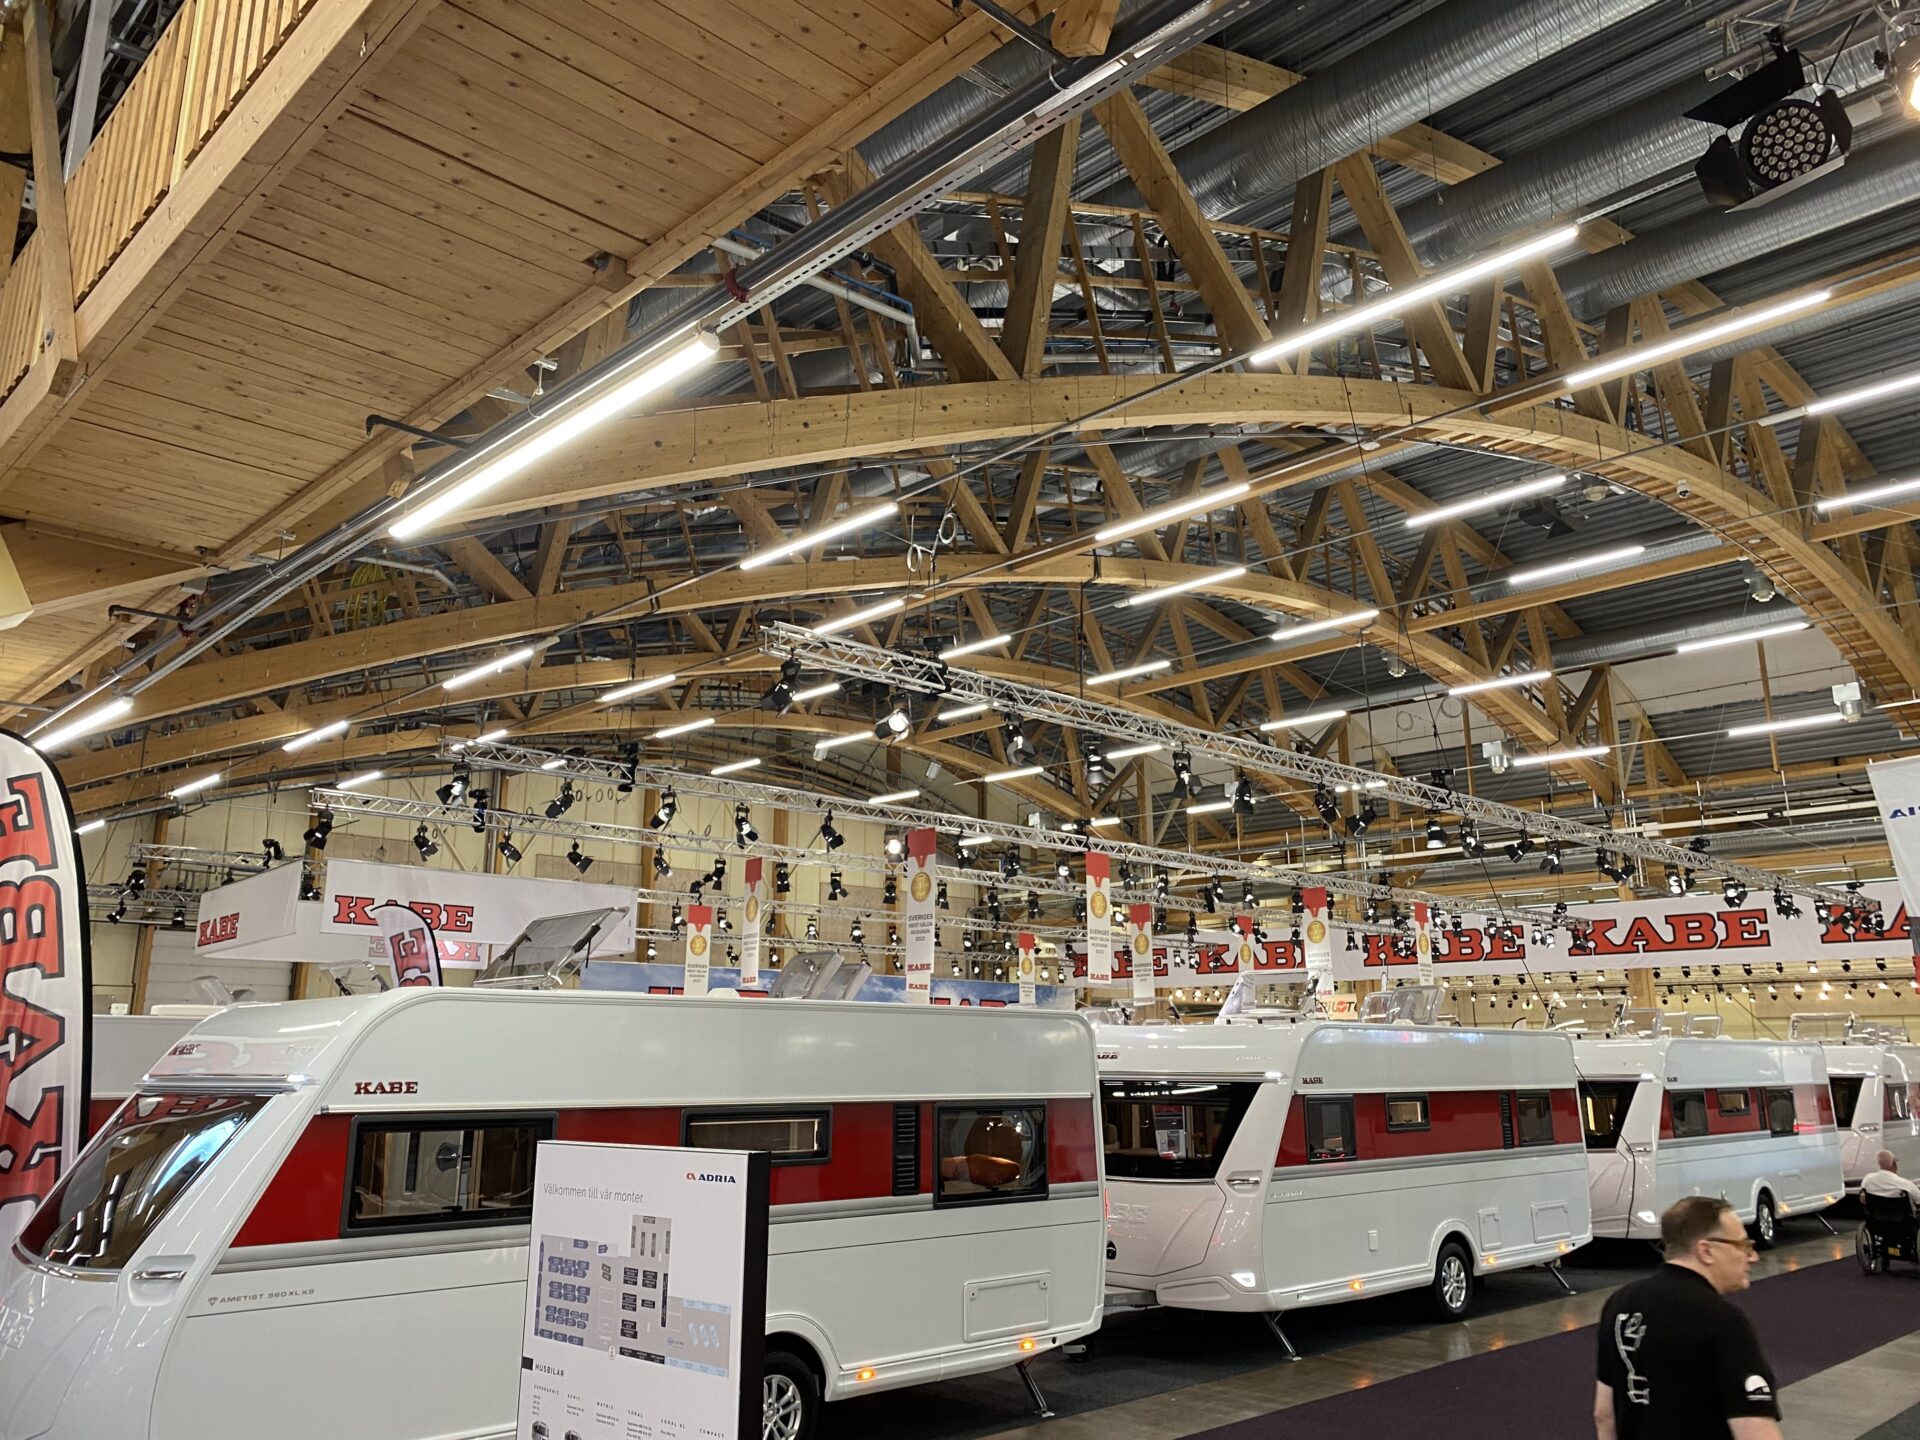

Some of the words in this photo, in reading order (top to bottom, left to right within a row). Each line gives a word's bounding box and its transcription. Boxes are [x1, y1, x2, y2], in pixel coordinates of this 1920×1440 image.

[332, 895, 474, 932] KBE
[197, 912, 240, 947] KABE
[1568, 908, 1771, 957] KABE
[354, 1081, 418, 1095] KABE
[698, 1173, 737, 1184] ADRIA
[543, 1183, 587, 1199] Välkommen
[588, 1186, 599, 1200] till
[600, 1188, 612, 1201] vår
[613, 1190, 644, 1204] monter
[219, 1293, 264, 1304] AMETIST
[535, 1363, 565, 1377] HUSBILAR
